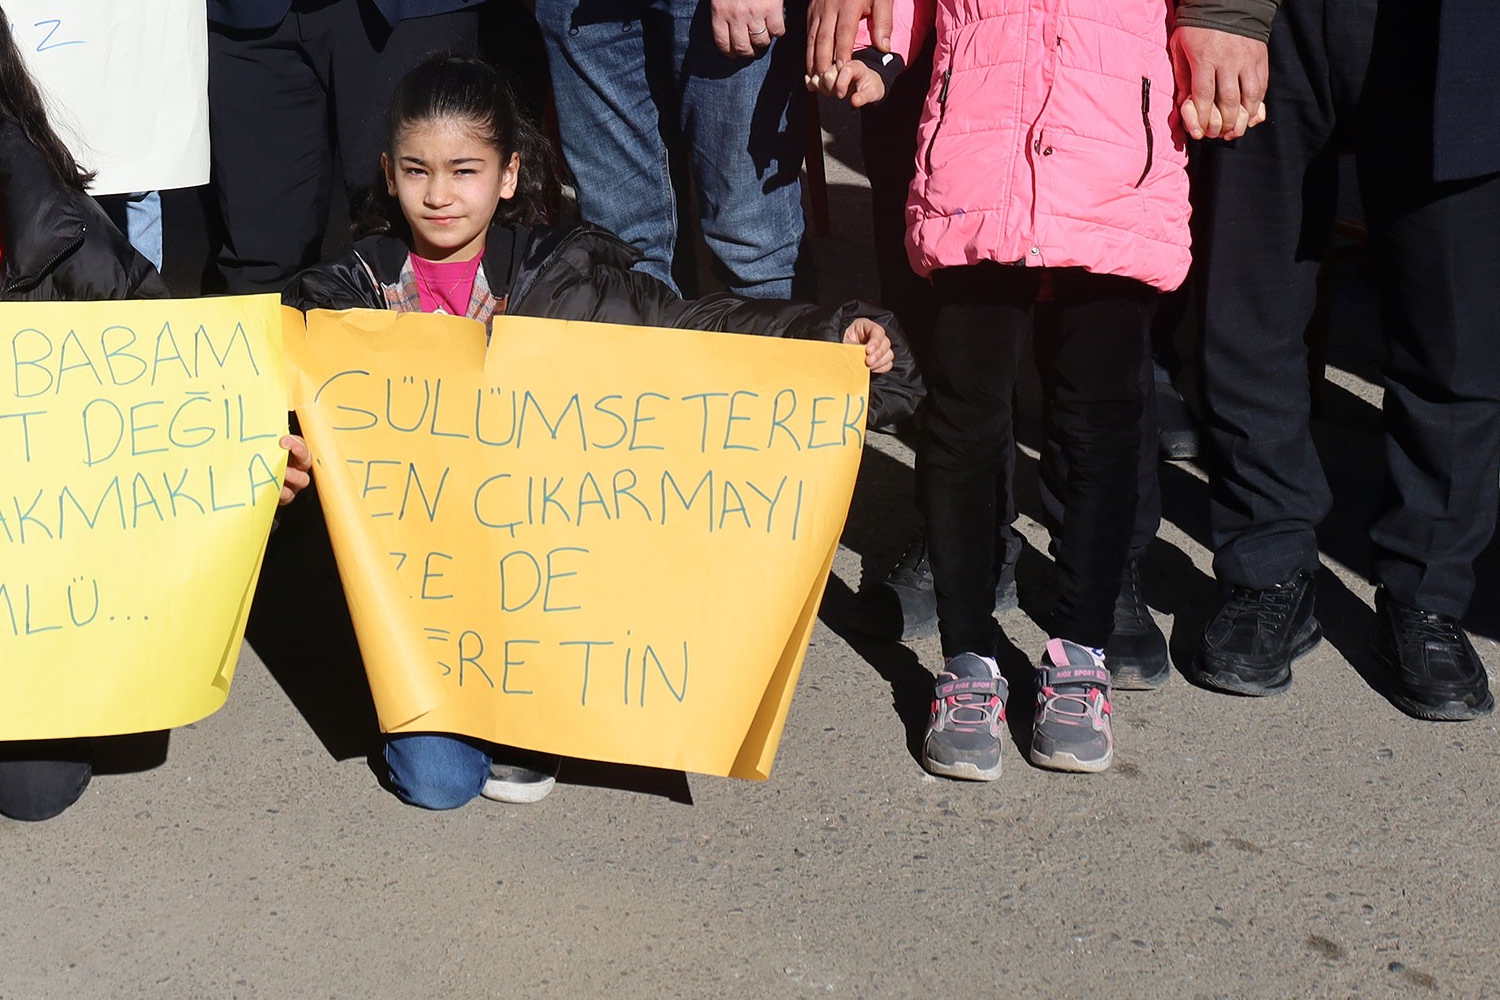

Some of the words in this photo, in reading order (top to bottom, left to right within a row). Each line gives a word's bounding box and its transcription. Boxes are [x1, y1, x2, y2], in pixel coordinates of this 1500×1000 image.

[12, 320, 261, 399] BABAM
[83, 384, 279, 468] DEĞİL
[474, 468, 805, 541] ÇIKARMAYI
[500, 546, 591, 613] DE
[971, 680, 996, 690] SPORT
[1073, 668, 1096, 678] SPORT
